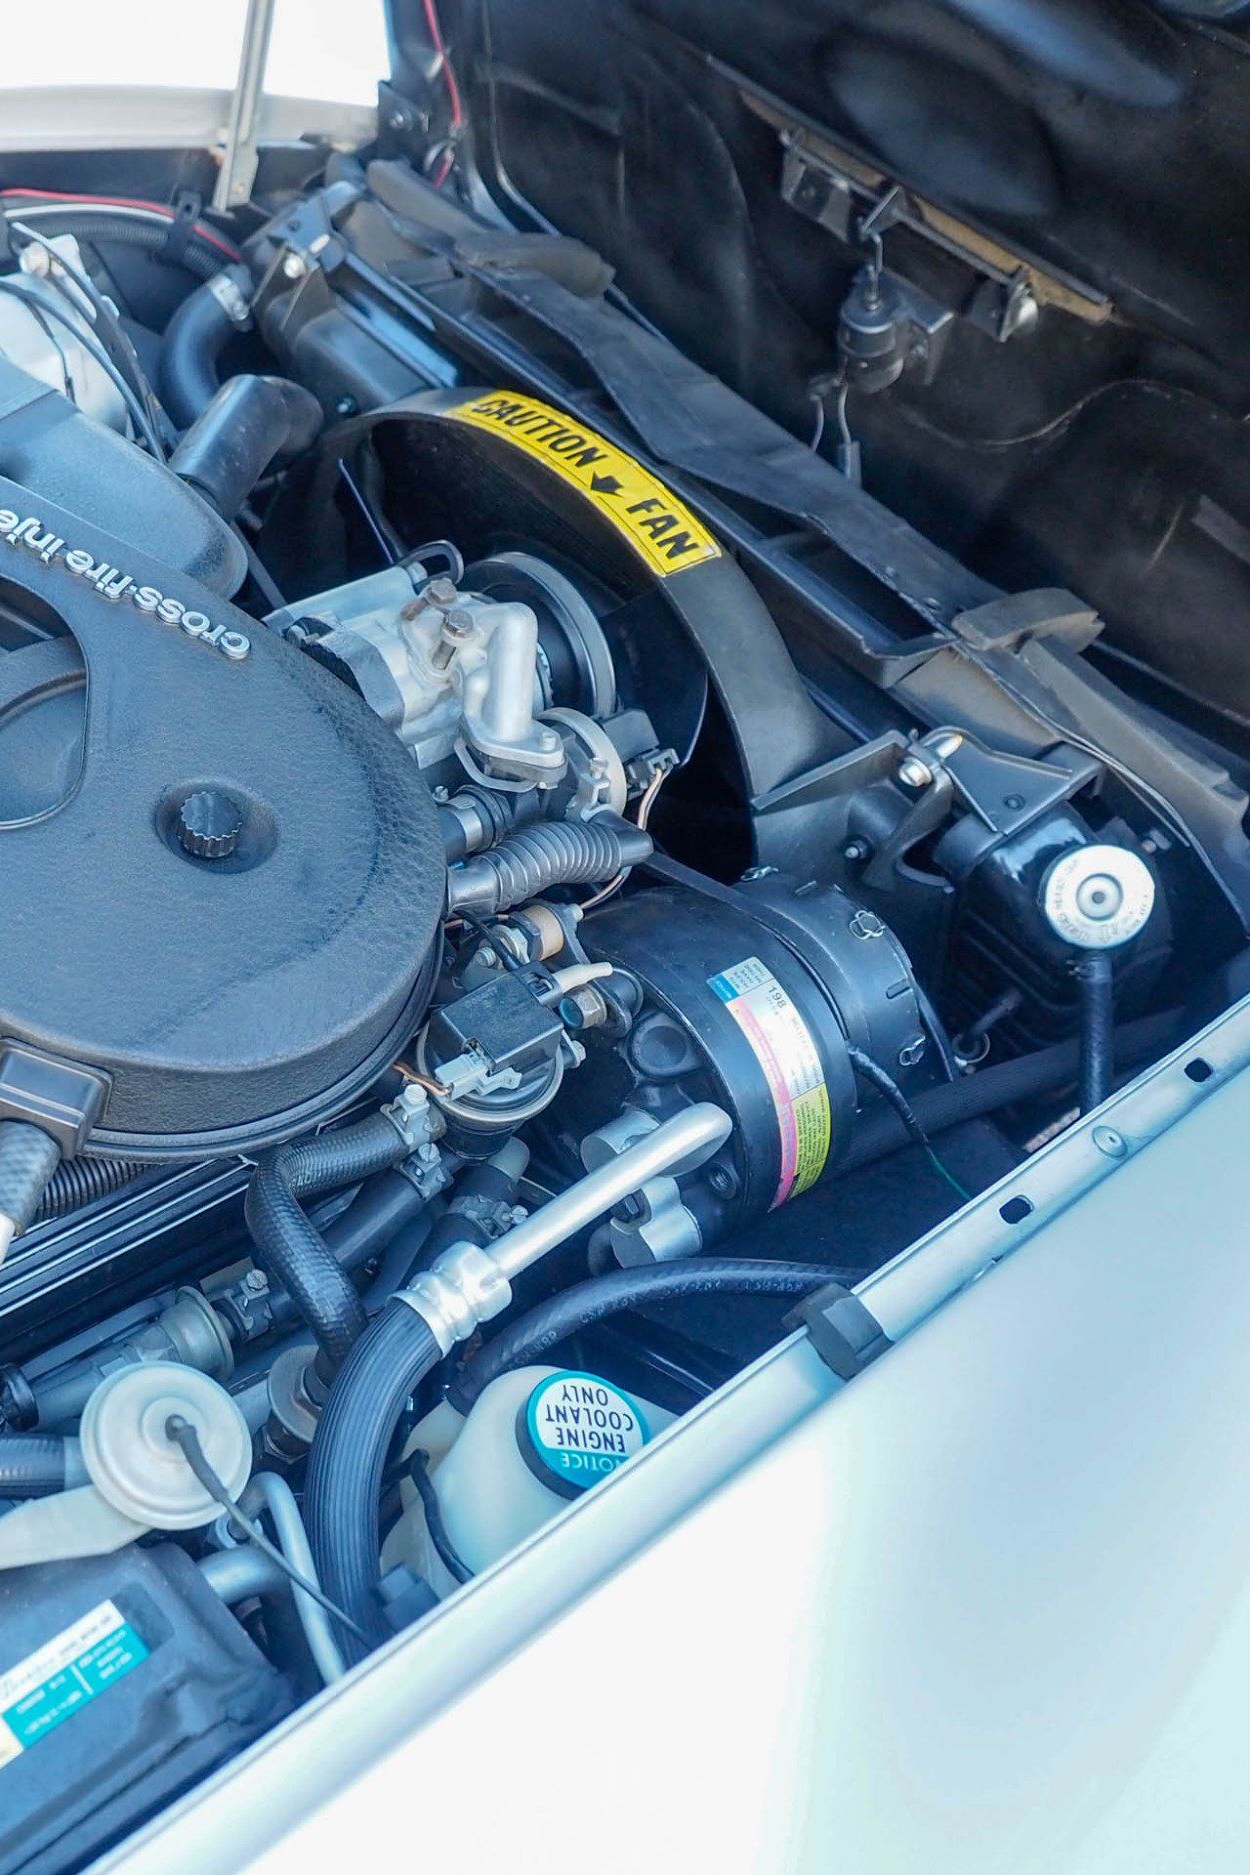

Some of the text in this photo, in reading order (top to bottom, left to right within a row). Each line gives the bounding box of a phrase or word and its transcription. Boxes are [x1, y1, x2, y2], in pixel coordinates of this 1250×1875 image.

[472, 399, 699, 560] CAUTION FAN
[65, 549, 252, 661] cross-fire
[562, 1385, 608, 1406] ONLY
[545, 1404, 633, 1432] COOLANT
[556, 1427, 626, 1453] ENGINE
